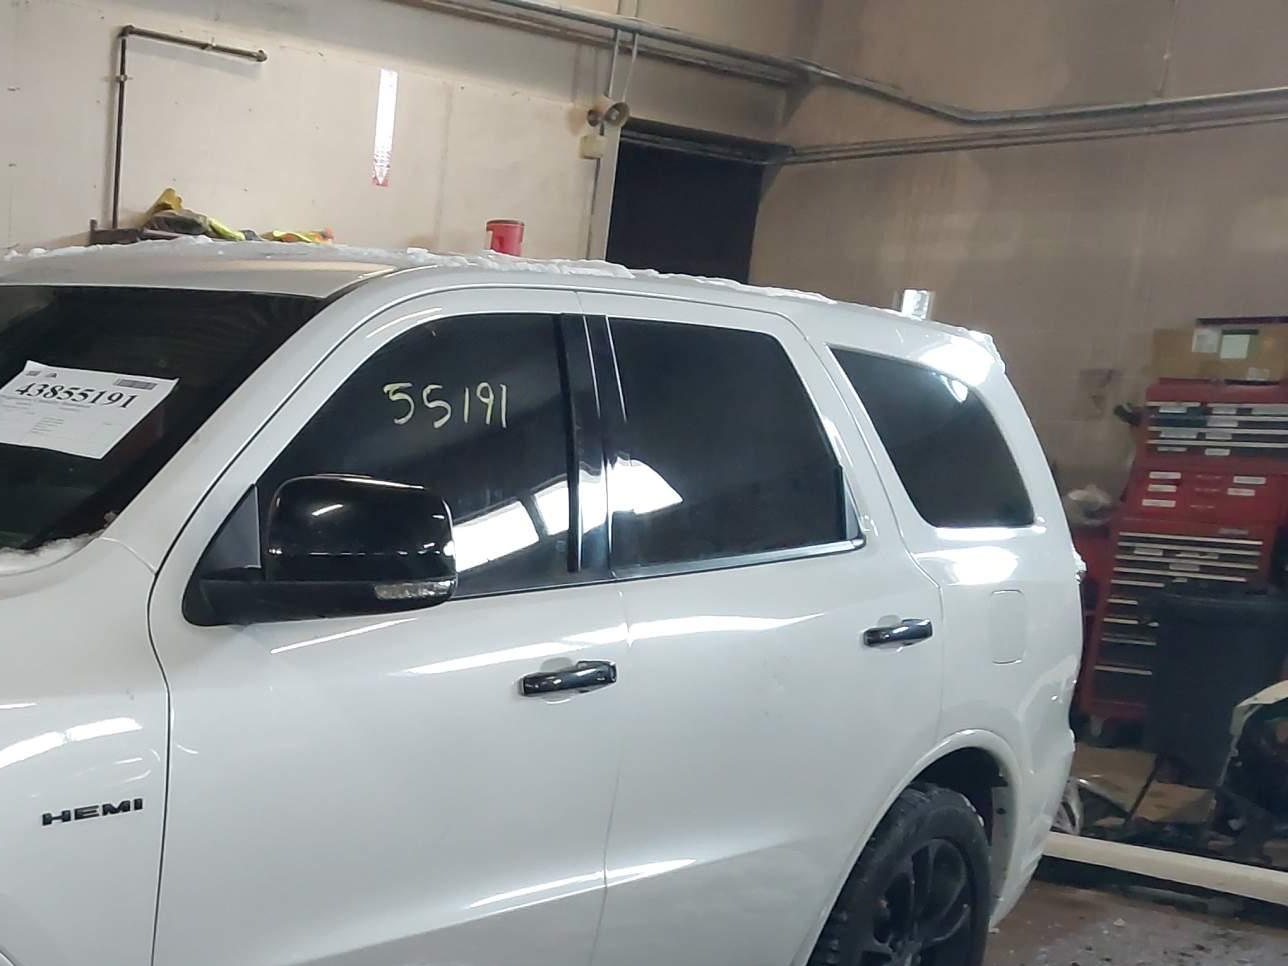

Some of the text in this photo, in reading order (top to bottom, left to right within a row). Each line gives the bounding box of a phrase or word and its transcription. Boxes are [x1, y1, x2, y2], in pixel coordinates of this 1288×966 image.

[16, 382, 138, 409] 43855191
[383, 382, 508, 429] 55191
[42, 798, 143, 826] HEMI
